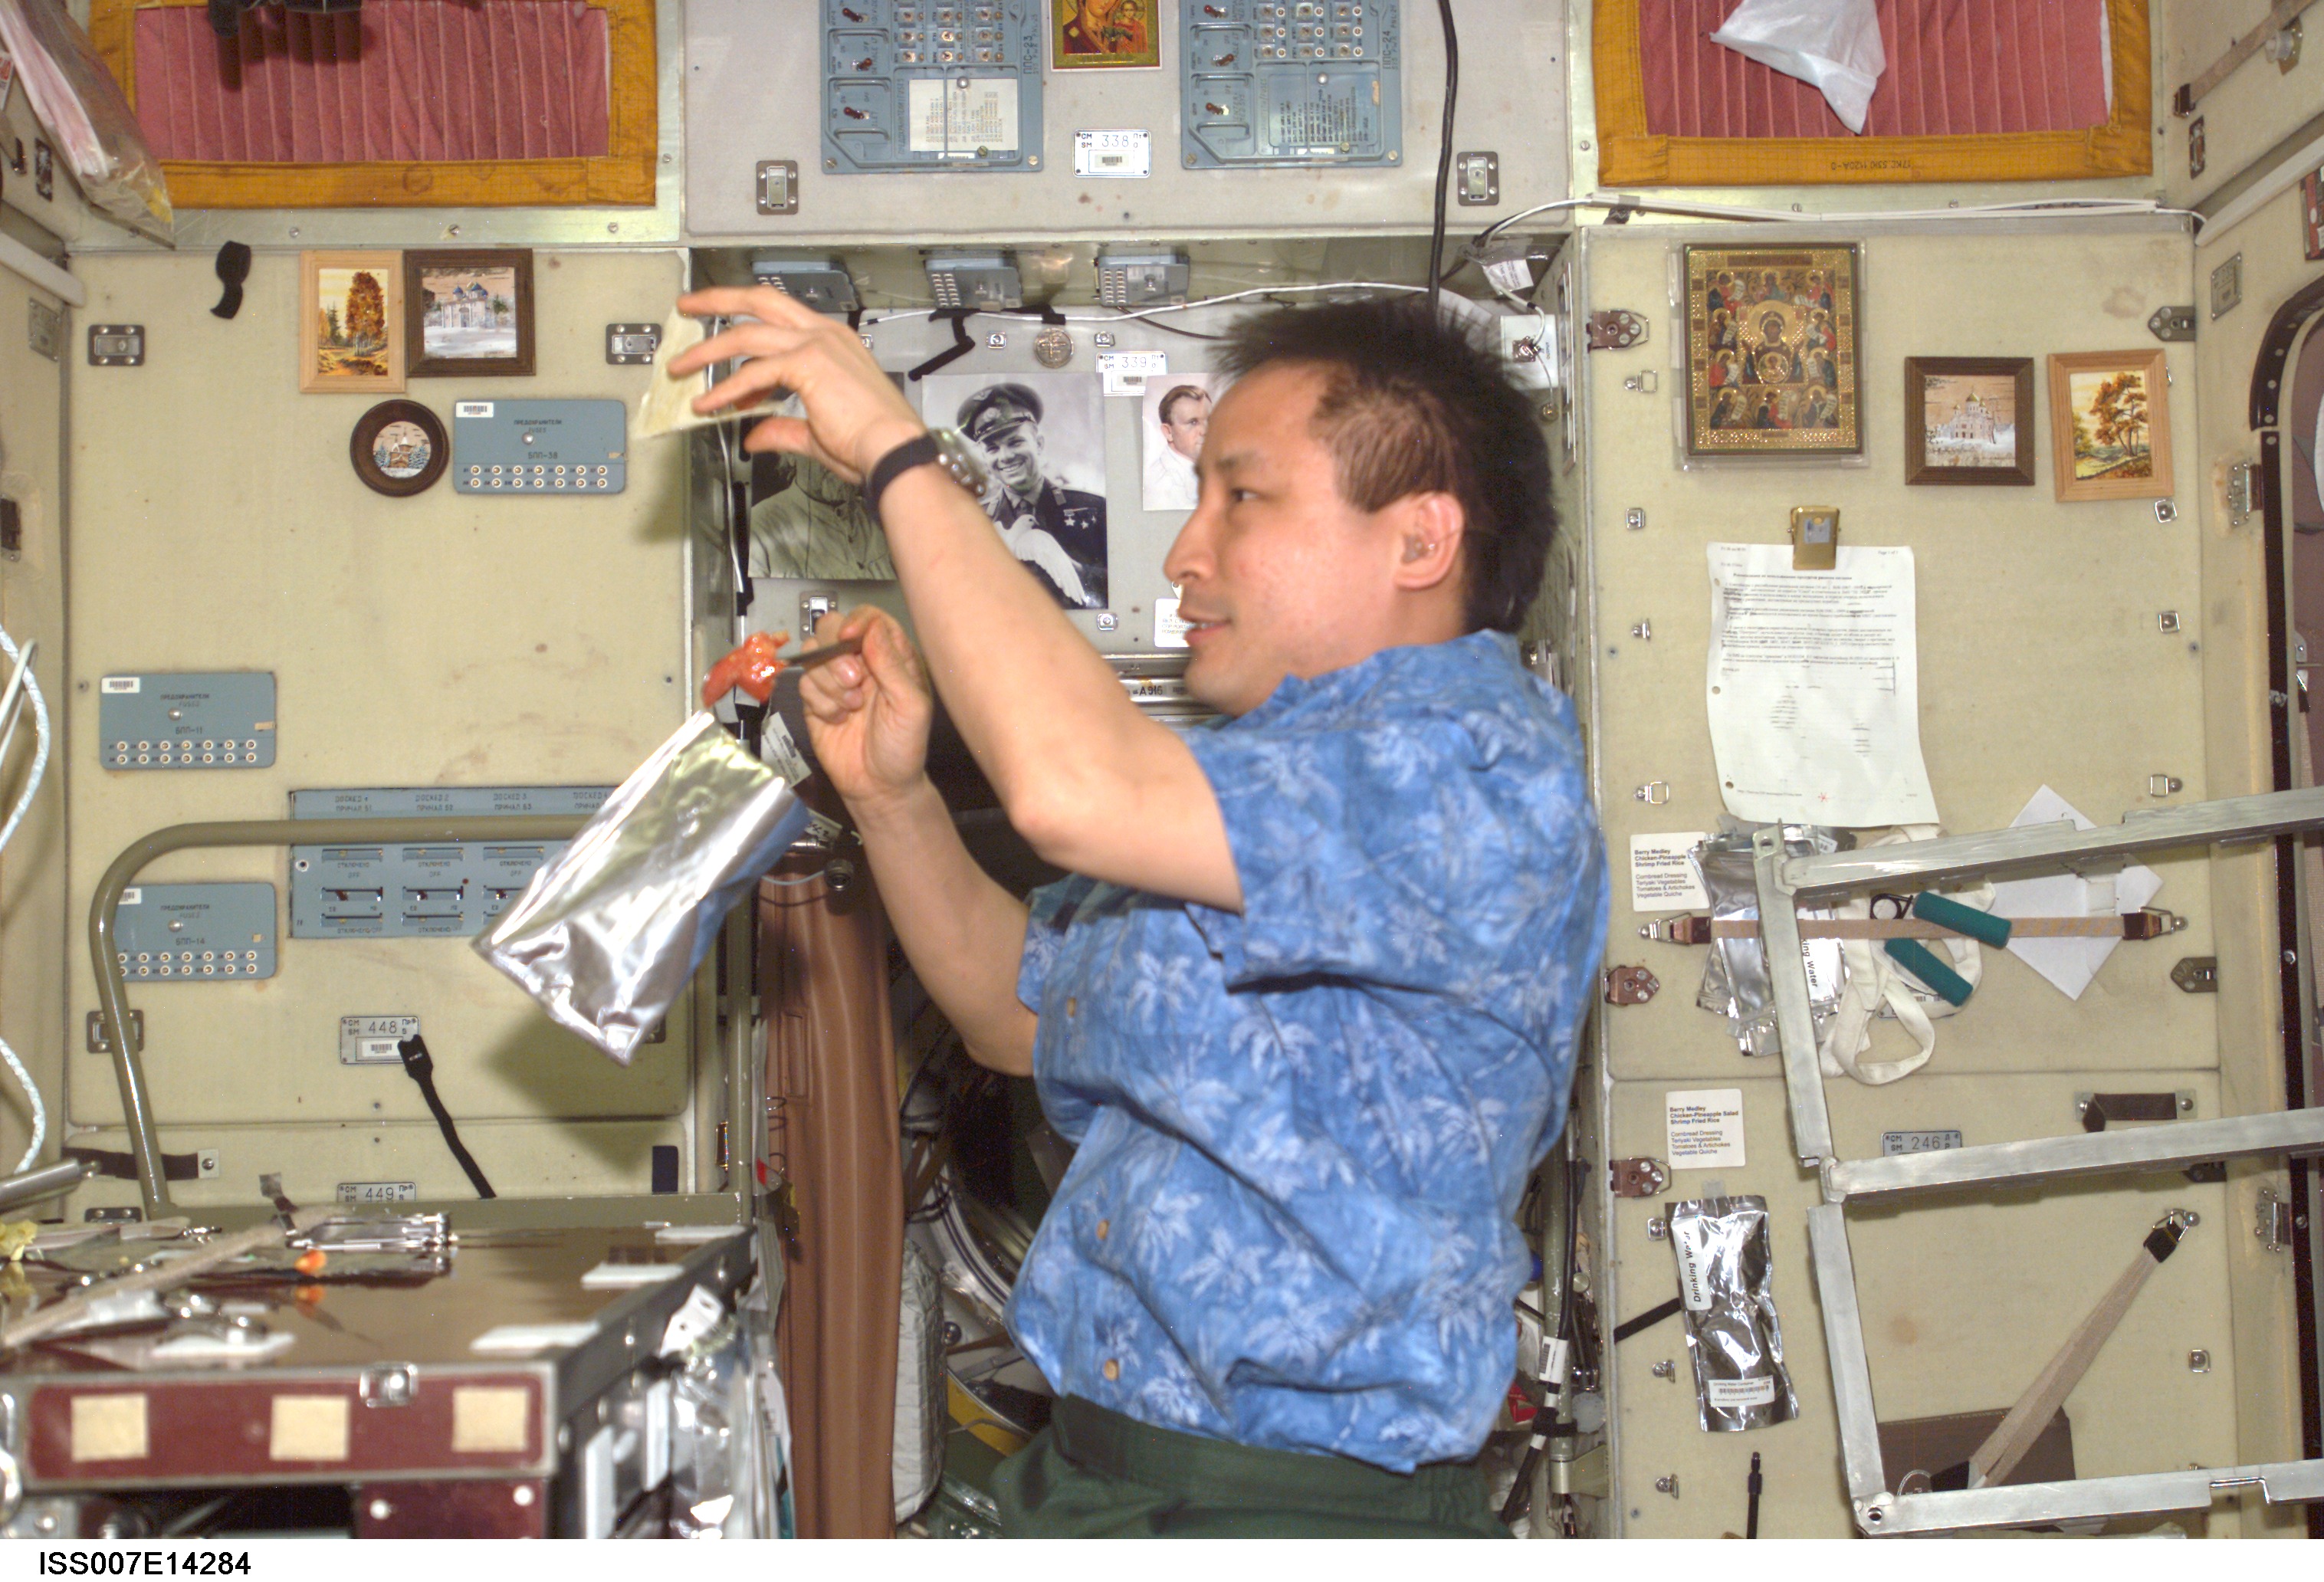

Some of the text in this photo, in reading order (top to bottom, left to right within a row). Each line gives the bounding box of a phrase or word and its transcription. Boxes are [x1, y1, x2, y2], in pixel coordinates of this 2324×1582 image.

[1102, 134, 1128, 147] 338
[1122, 356, 1147, 368] 339
[1807, 960, 1818, 987] Water
[368, 1021, 397, 1034] 448
[1911, 1136, 1940, 1150] 246
[365, 1186, 394, 1203] 449
[1689, 1262, 1702, 1302] Drinking
